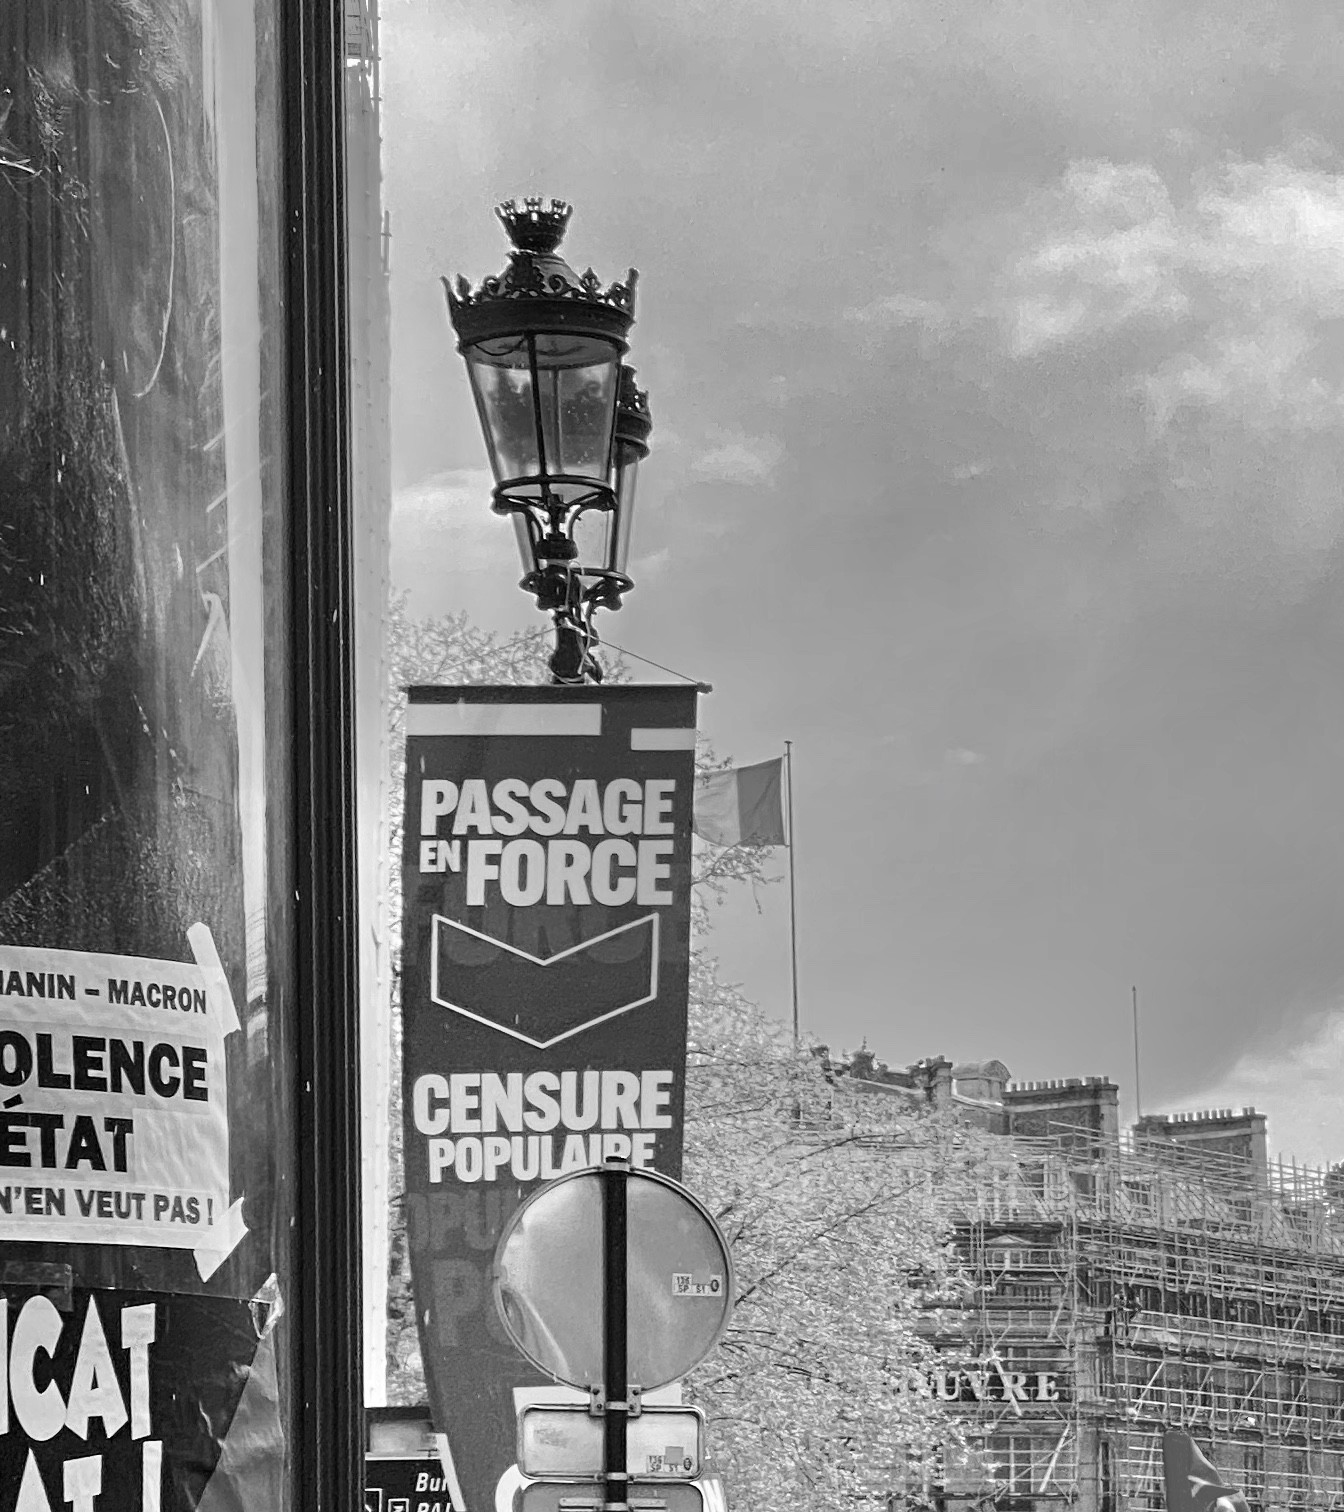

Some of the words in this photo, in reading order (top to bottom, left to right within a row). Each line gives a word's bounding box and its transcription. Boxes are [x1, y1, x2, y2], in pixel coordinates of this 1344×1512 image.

[420, 778, 676, 836] PASSAGE
[419, 840, 461, 873] EN
[466, 840, 674, 907] FORCE
[0, 969, 75, 1000] ANIN
[107, 978, 207, 1014] MACRON
[0, 1030, 208, 1101] OLENCE
[0, 1093, 133, 1173] ÉTAT
[413, 1070, 674, 1136] CENSURE
[74, 1188, 146, 1221] VEUT
[153, 1193, 200, 1225] PAS
[917, 1369, 1059, 1401] UVRE
